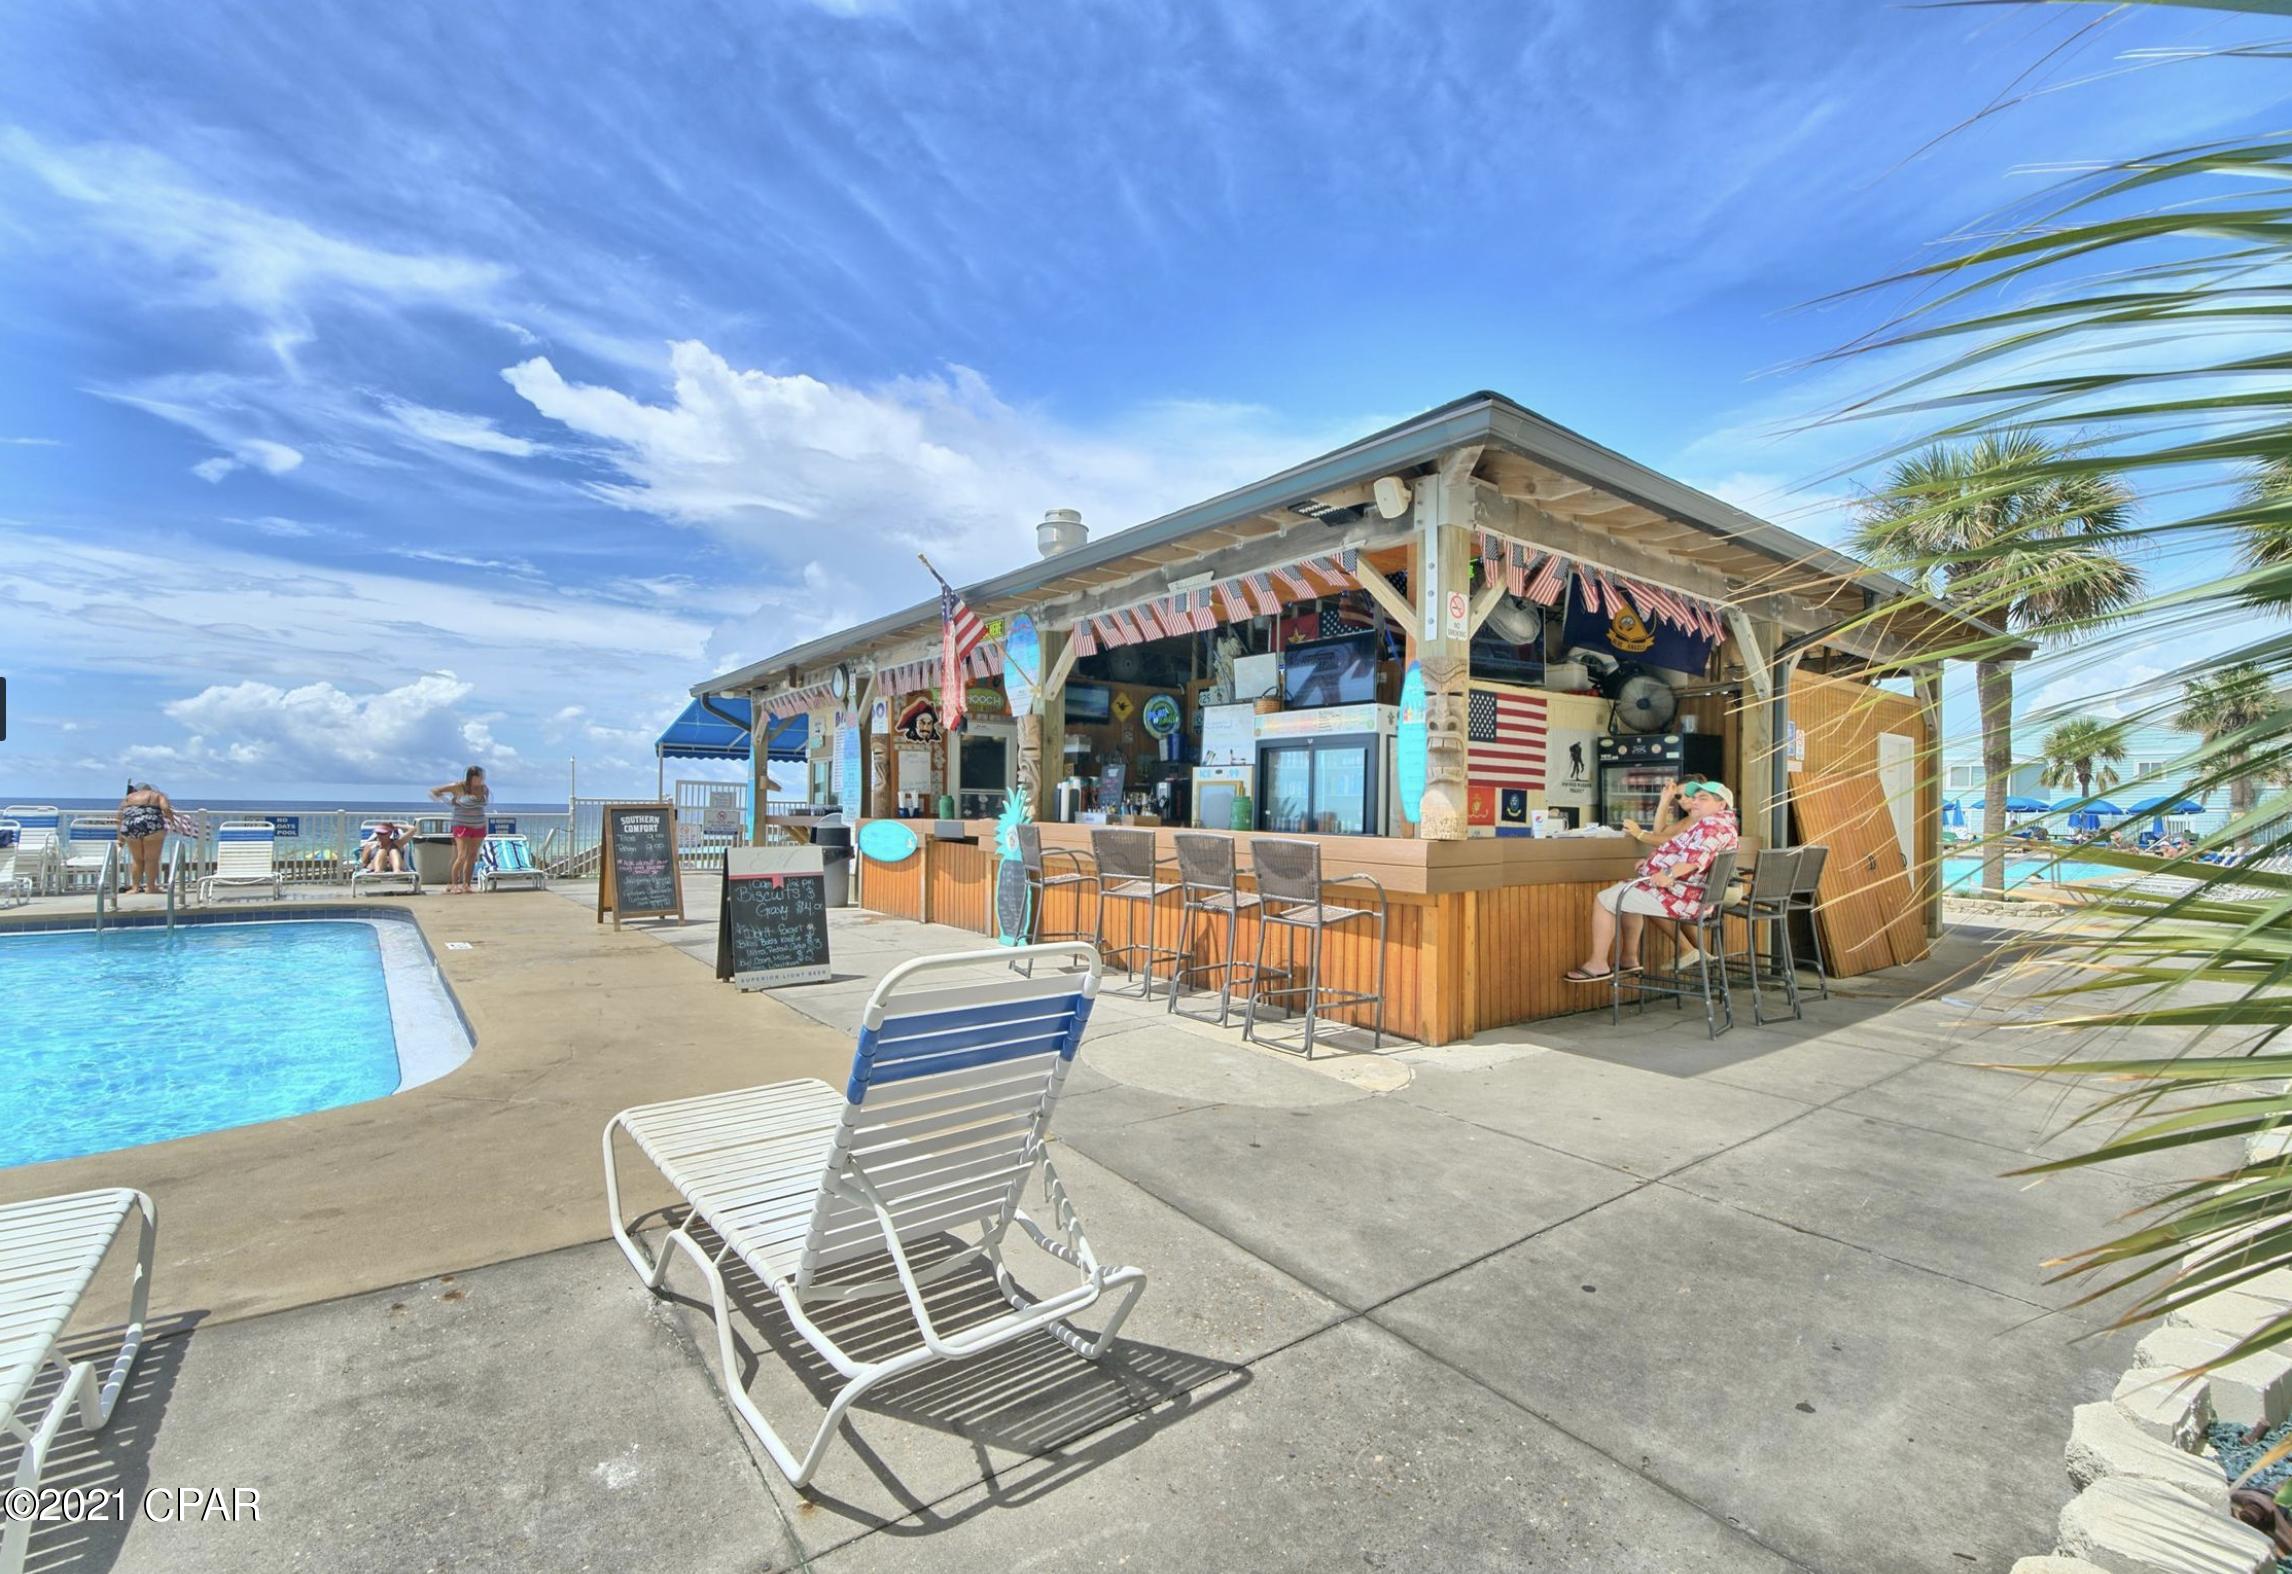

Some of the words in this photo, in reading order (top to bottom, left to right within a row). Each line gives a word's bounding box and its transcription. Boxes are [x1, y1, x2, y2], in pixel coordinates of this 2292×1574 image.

[620, 815, 660, 825] SOUTHERN
[623, 824, 659, 833] COMFORT
[735, 886, 801, 903] Biscuits
[755, 902, 789, 920] Gravy
[741, 974, 780, 983] SUPERIOR
[782, 971, 805, 979] LIGHT
